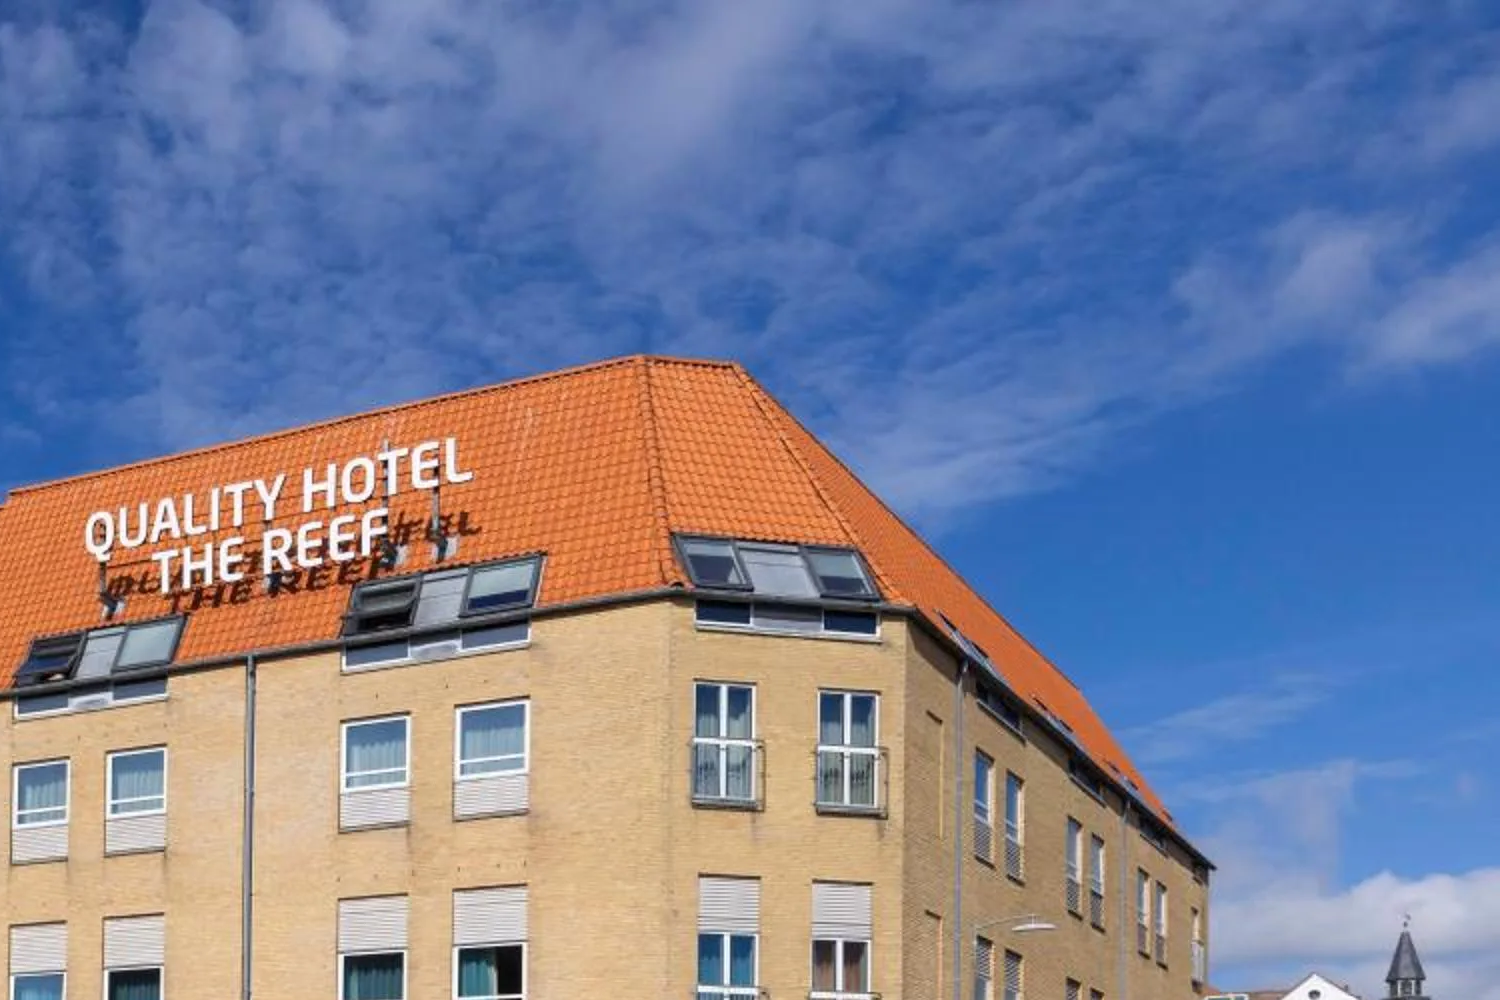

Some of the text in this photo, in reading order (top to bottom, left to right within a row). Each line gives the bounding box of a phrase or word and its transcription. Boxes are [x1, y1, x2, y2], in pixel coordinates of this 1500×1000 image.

[84, 437, 473, 561] QUALITY HOTEL
[151, 508, 389, 594] THE REEF
